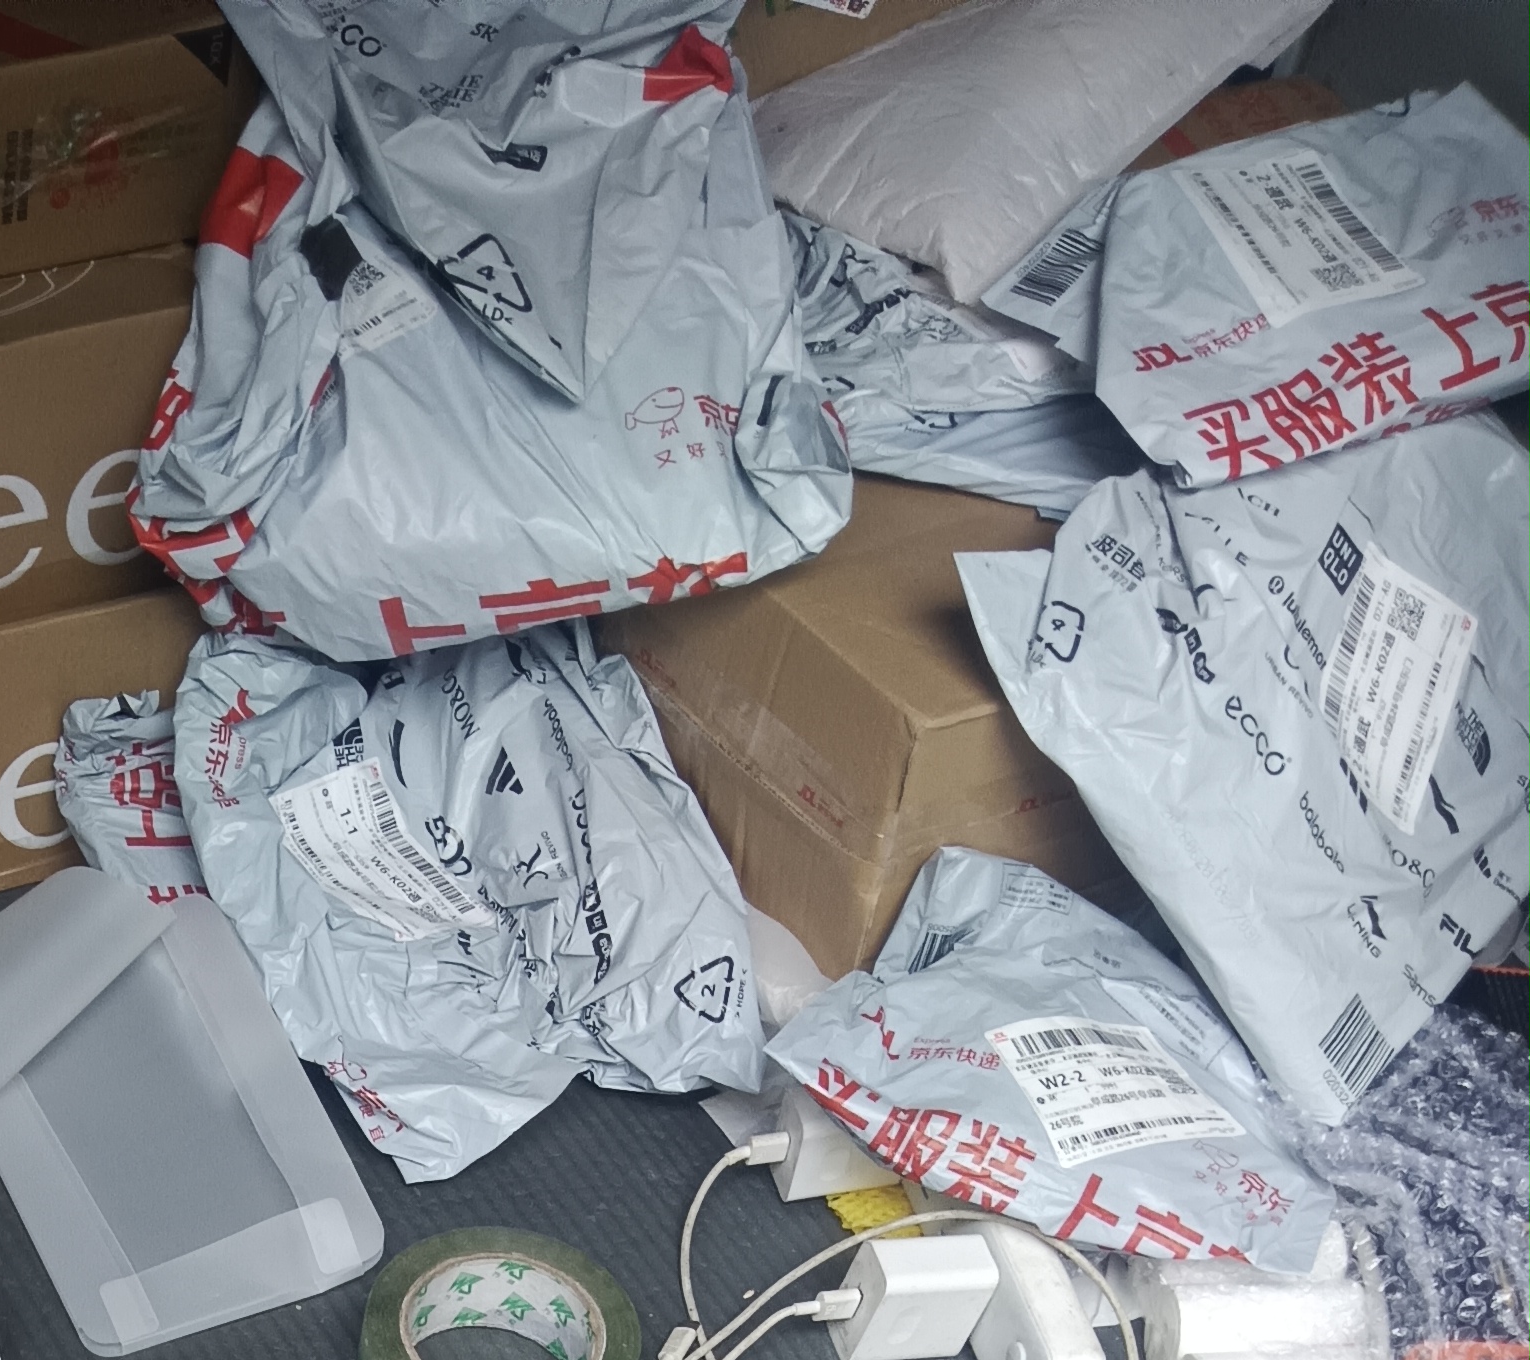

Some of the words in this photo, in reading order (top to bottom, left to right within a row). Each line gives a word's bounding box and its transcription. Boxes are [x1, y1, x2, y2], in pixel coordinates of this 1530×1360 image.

[1132, 342, 1193, 372] JDL
[1182, 331, 1412, 482] 买服装
[1331, 528, 1356, 568] UNI
[1322, 550, 1348, 587] QLO
[233, 735, 247, 770] press
[1224, 695, 1286, 777] ecco
[1298, 790, 1346, 874] balabala
[1439, 912, 1479, 959] FIL
[907, 1046, 1002, 1072] 京东快递
[1038, 1069, 1087, 1091] W2-2
